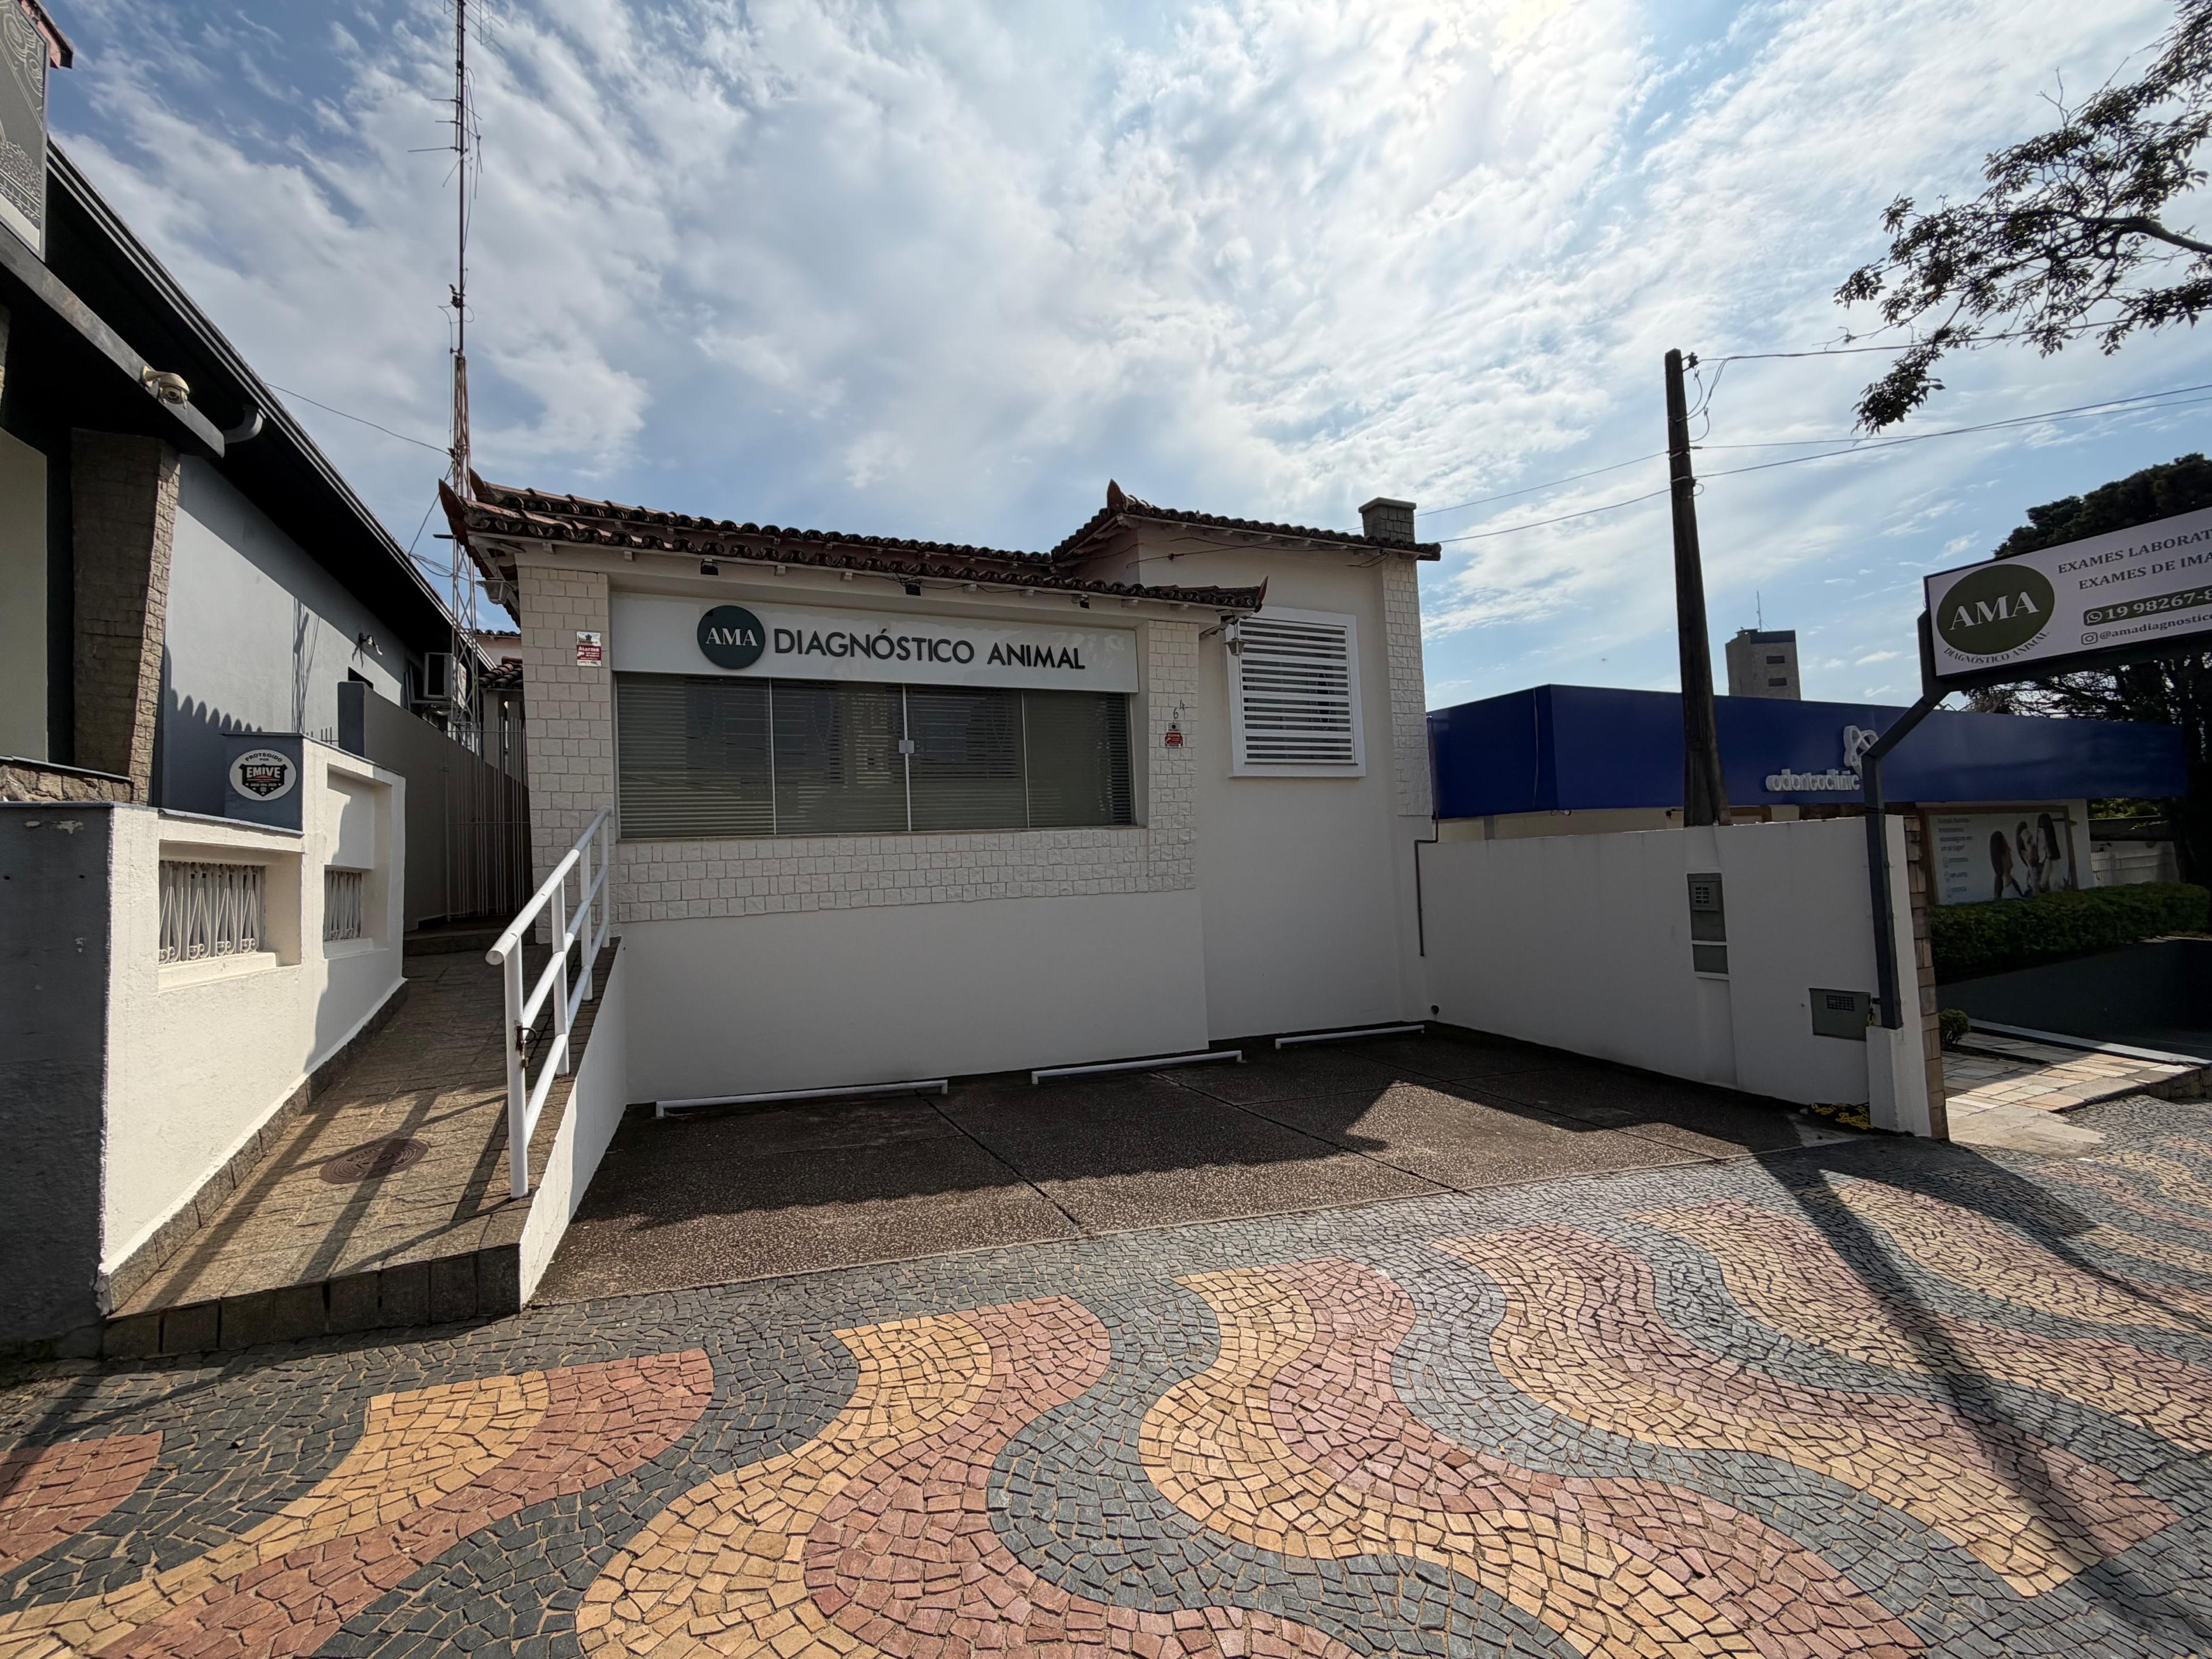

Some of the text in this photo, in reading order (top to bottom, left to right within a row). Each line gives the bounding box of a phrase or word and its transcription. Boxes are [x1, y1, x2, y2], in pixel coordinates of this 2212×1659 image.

[2058, 529, 2212, 574] EXAMES LABORAT
[2078, 567, 2146, 590] EXAMES
[2152, 560, 2175, 574] DE
[1949, 591, 2040, 631] AMA
[2106, 606, 2128, 620] 19
[705, 627, 758, 646] AMA
[774, 628, 1086, 669] DIAGNÓSTICO ANIMAL
[1944, 631, 2048, 664] DIAGNÓSTICO ANIMAL
[245, 752, 283, 762] PROTEGIDO
[247, 767, 281, 778] EMIVE
[1766, 768, 1860, 791] odontoclinic
